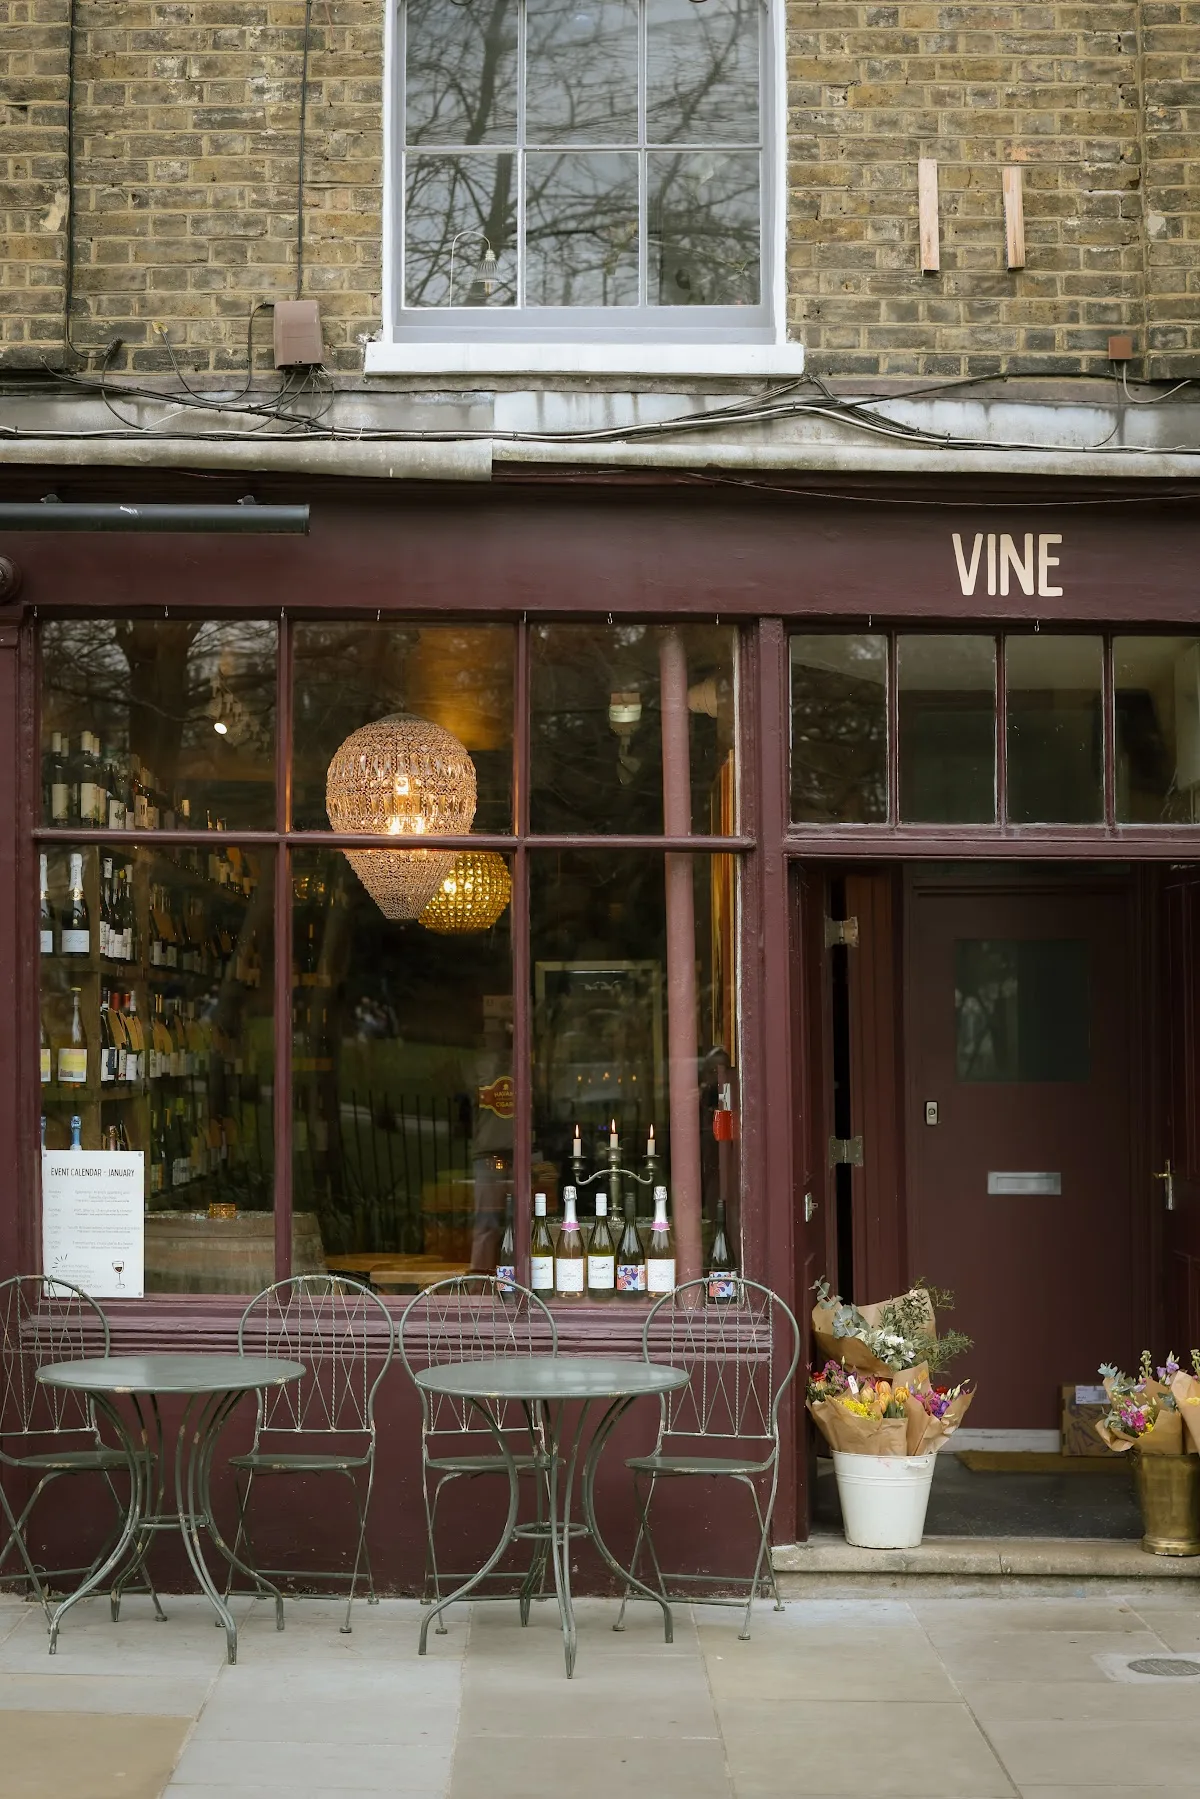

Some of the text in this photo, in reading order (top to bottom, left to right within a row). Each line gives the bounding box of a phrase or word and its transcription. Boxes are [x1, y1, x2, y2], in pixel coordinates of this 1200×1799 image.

[952, 533, 1063, 596] VINE
[51, 1167, 69, 1176] EVENT
[71, 1168, 102, 1177] CALENDAR
[108, 1168, 135, 1177] JANUARY
